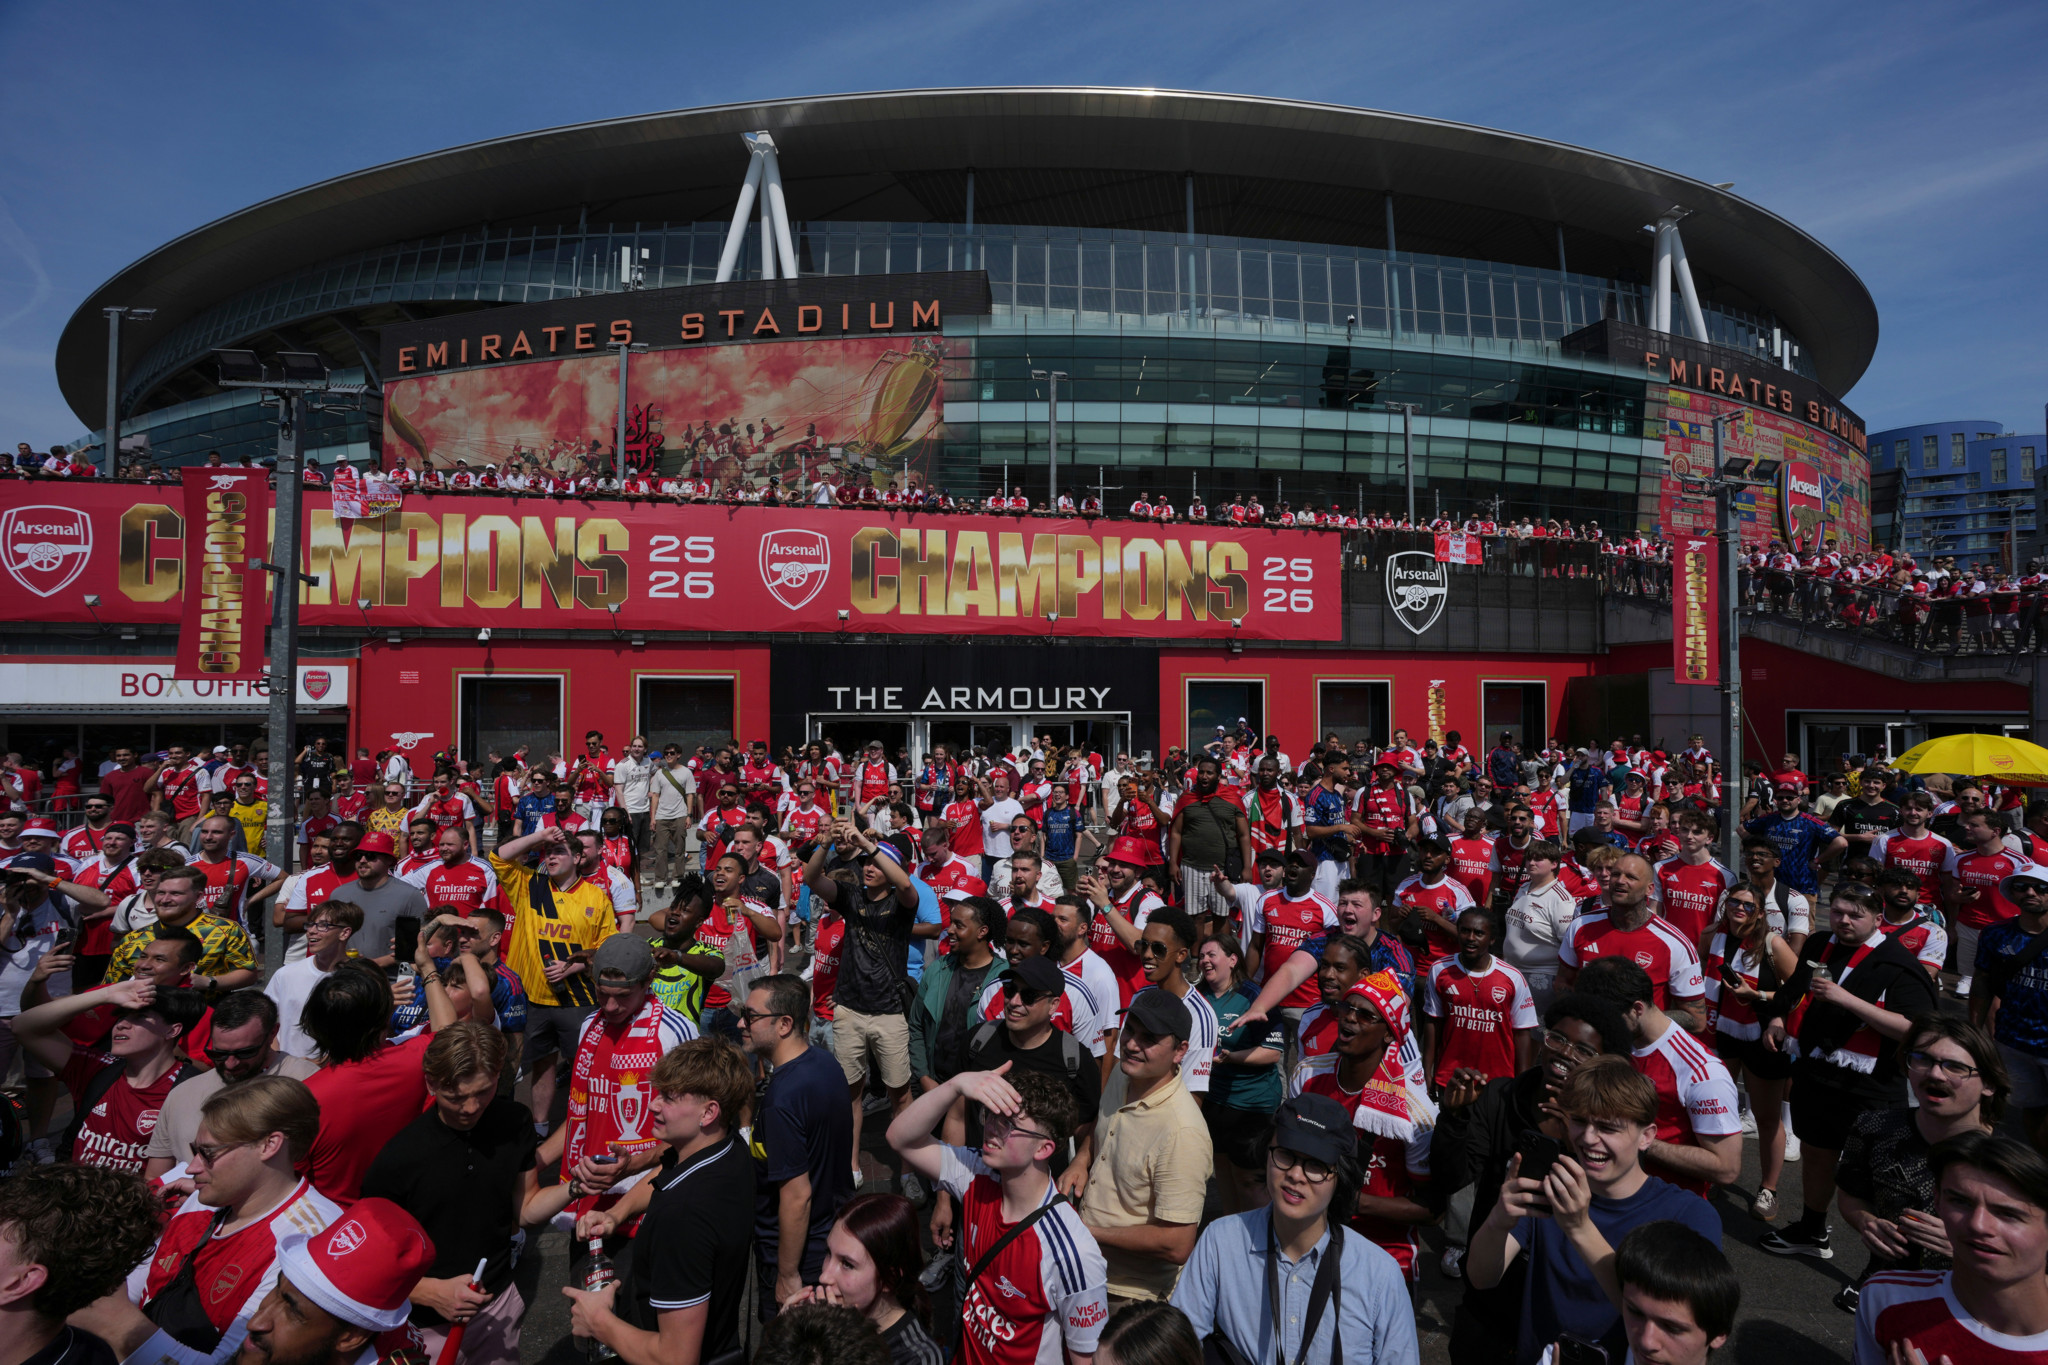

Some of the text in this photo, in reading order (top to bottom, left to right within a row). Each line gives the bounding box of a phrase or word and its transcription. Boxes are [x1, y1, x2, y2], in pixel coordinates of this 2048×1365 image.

[398, 299, 940, 373] EMIRATES STADIUM
[1645, 352, 1868, 455] EMIRATES STADIUM
[1790, 475, 1821, 500] Arsenal
[13, 519, 81, 537] Arsenal
[648, 534, 715, 563] 25
[769, 542, 821, 558] Arsenal
[850, 526, 1249, 622] CHAMPIONS
[1263, 557, 1314, 582] 25
[1394, 566, 1440, 582] Arsenal
[197, 490, 248, 674] CHAMPIONS
[648, 570, 715, 599] 26
[1263, 588, 1315, 614] 26
[1684, 553, 1708, 680] CHAMPIONS
[121, 672, 184, 697] BOX
[306, 672, 328, 680] Arsenal
[828, 686, 1112, 710] THE ARMOURY
[1854, 822, 1889, 833] Emirates
[1453, 857, 1490, 870] Emirates
[1468, 866, 1485, 876] BETTER
[1894, 856, 1939, 869] Emirates
[1961, 869, 2000, 881] Emirates
[433, 883, 478, 894] Emirates
[439, 893, 470, 901] FLY BETTER
[1666, 888, 1714, 905] Emirates
[1672, 899, 1707, 912] FLY BETTER
[538, 922, 572, 939] JVC
[1266, 921, 1313, 938] Emirates
[699, 931, 728, 946] Emira
[1280, 936, 1304, 948] BETTER
[1689, 974, 1703, 986] de
[1447, 1001, 1503, 1023] Emirates
[1466, 1019, 1495, 1033] BETTER
[1690, 1106, 1729, 1115] RWANDA
[1696, 1098, 1719, 1108] VISIT
[346, 1224, 363, 1245] Arsenal
[1075, 1301, 1100, 1316] VISIT
[1069, 1308, 1108, 1328] RWANDA
